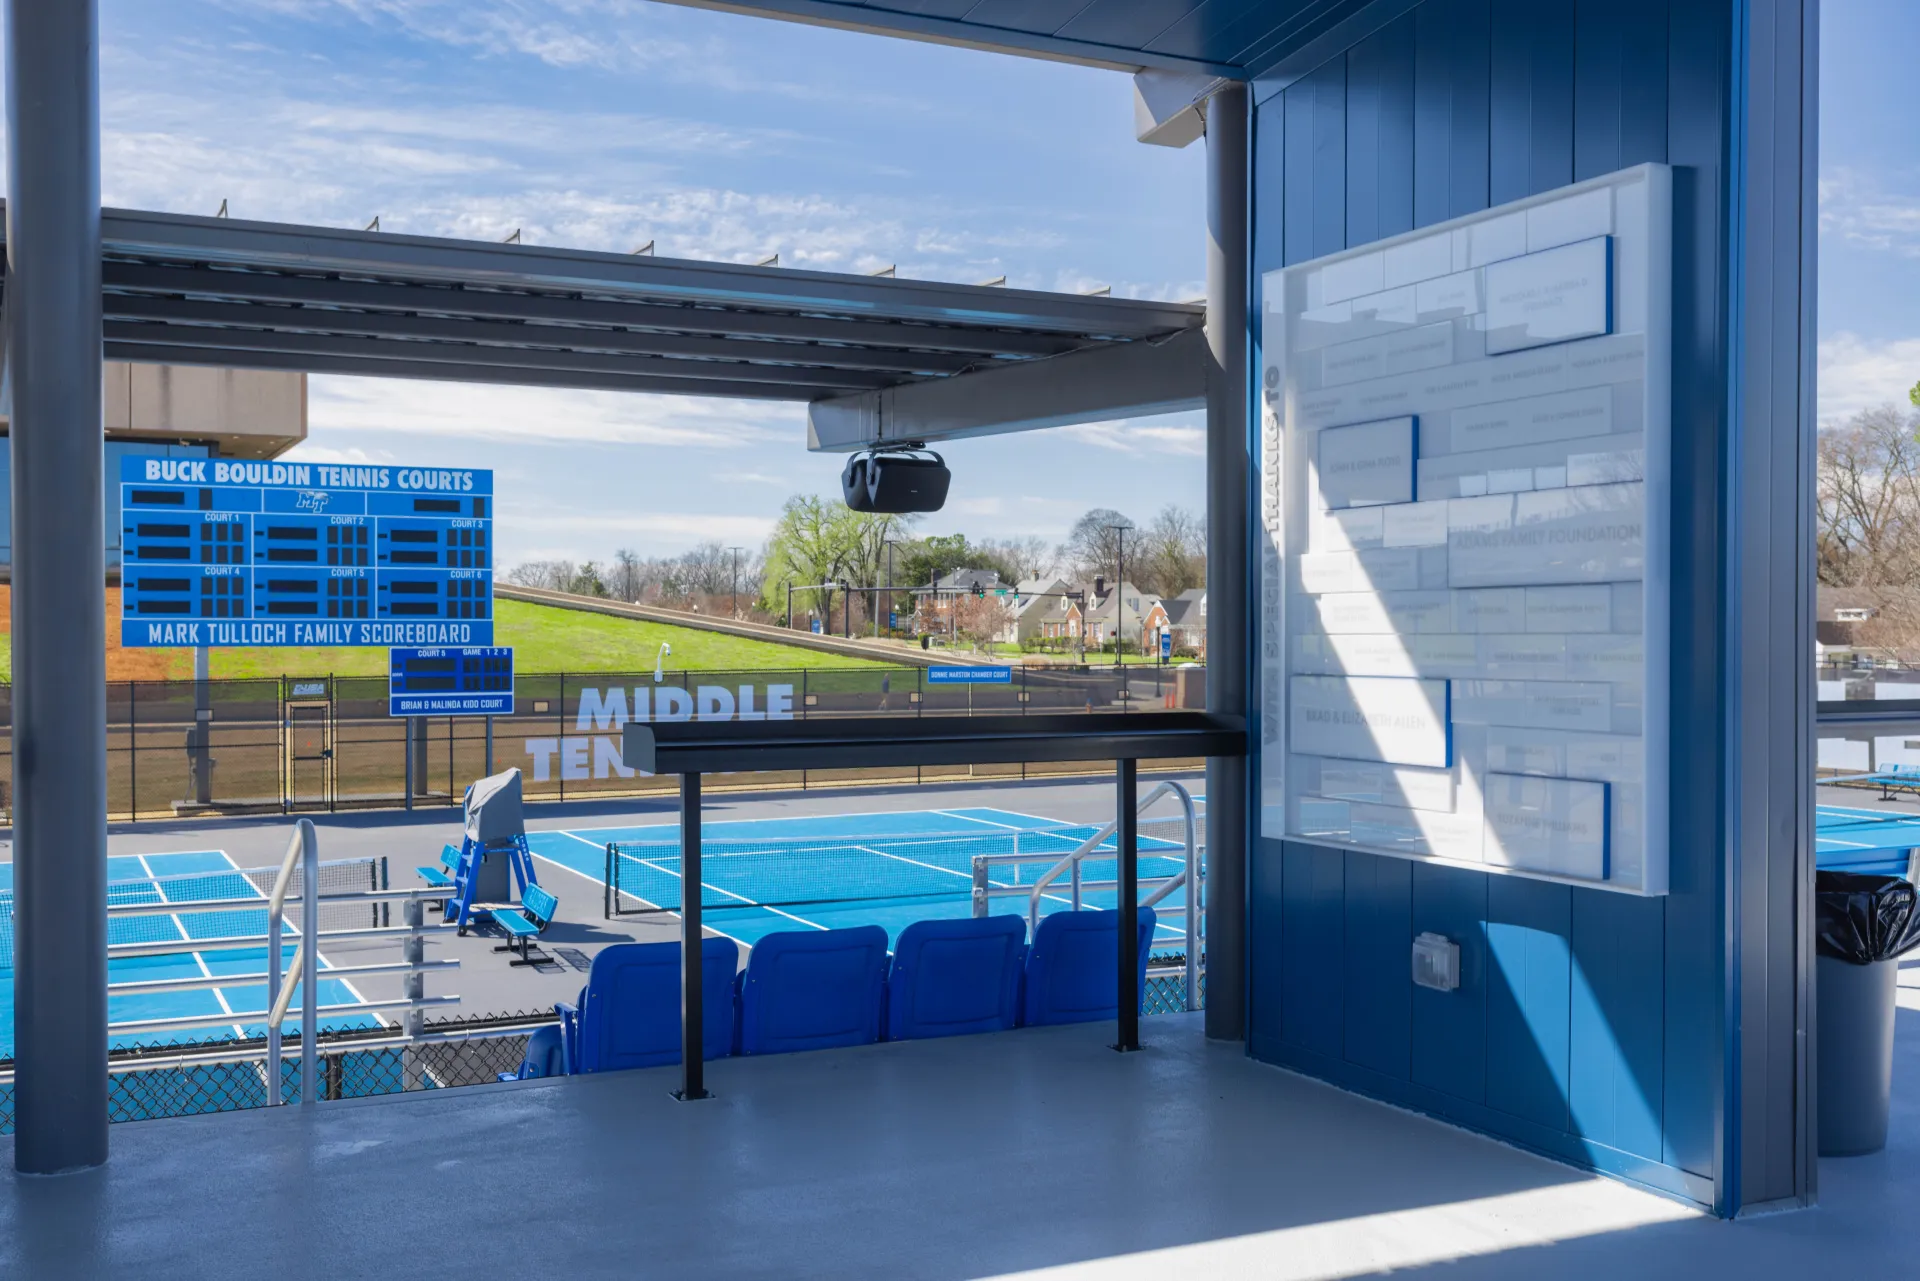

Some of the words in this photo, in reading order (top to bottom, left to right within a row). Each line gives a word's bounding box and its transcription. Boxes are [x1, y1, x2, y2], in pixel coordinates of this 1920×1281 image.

[1265, 366, 1280, 406] TO
[146, 460, 206, 481] BUCK
[215, 462, 310, 485] BOULDIN
[318, 466, 389, 488] TENNIS
[397, 470, 473, 491] COURTS
[1264, 412, 1280, 535] THANKS
[205, 513, 232, 521] COURT
[235, 513, 239, 521] 1
[331, 516, 357, 525] COURT
[359, 517, 364, 525] 2
[452, 520, 476, 528] COURT
[1549, 524, 1641, 544] FOUNDATION
[205, 566, 232, 575] COURT
[235, 567, 240, 575] 4
[331, 568, 357, 577] COURT
[359, 569, 364, 577] 5
[451, 570, 476, 579] COURT
[477, 571, 482, 579] 6
[1263, 541, 1279, 659] SPECIAL
[149, 623, 199, 643] MARK
[207, 623, 286, 643] TULLOCH
[294, 623, 353, 643] FAMILY
[361, 624, 471, 643] SCOREBOARD
[418, 649, 440, 657] COURT
[463, 648, 481, 656] GAME
[401, 700, 422, 710] BRIAN
[481, 699, 503, 708] COURT
[576, 684, 793, 731] MIDDLE
